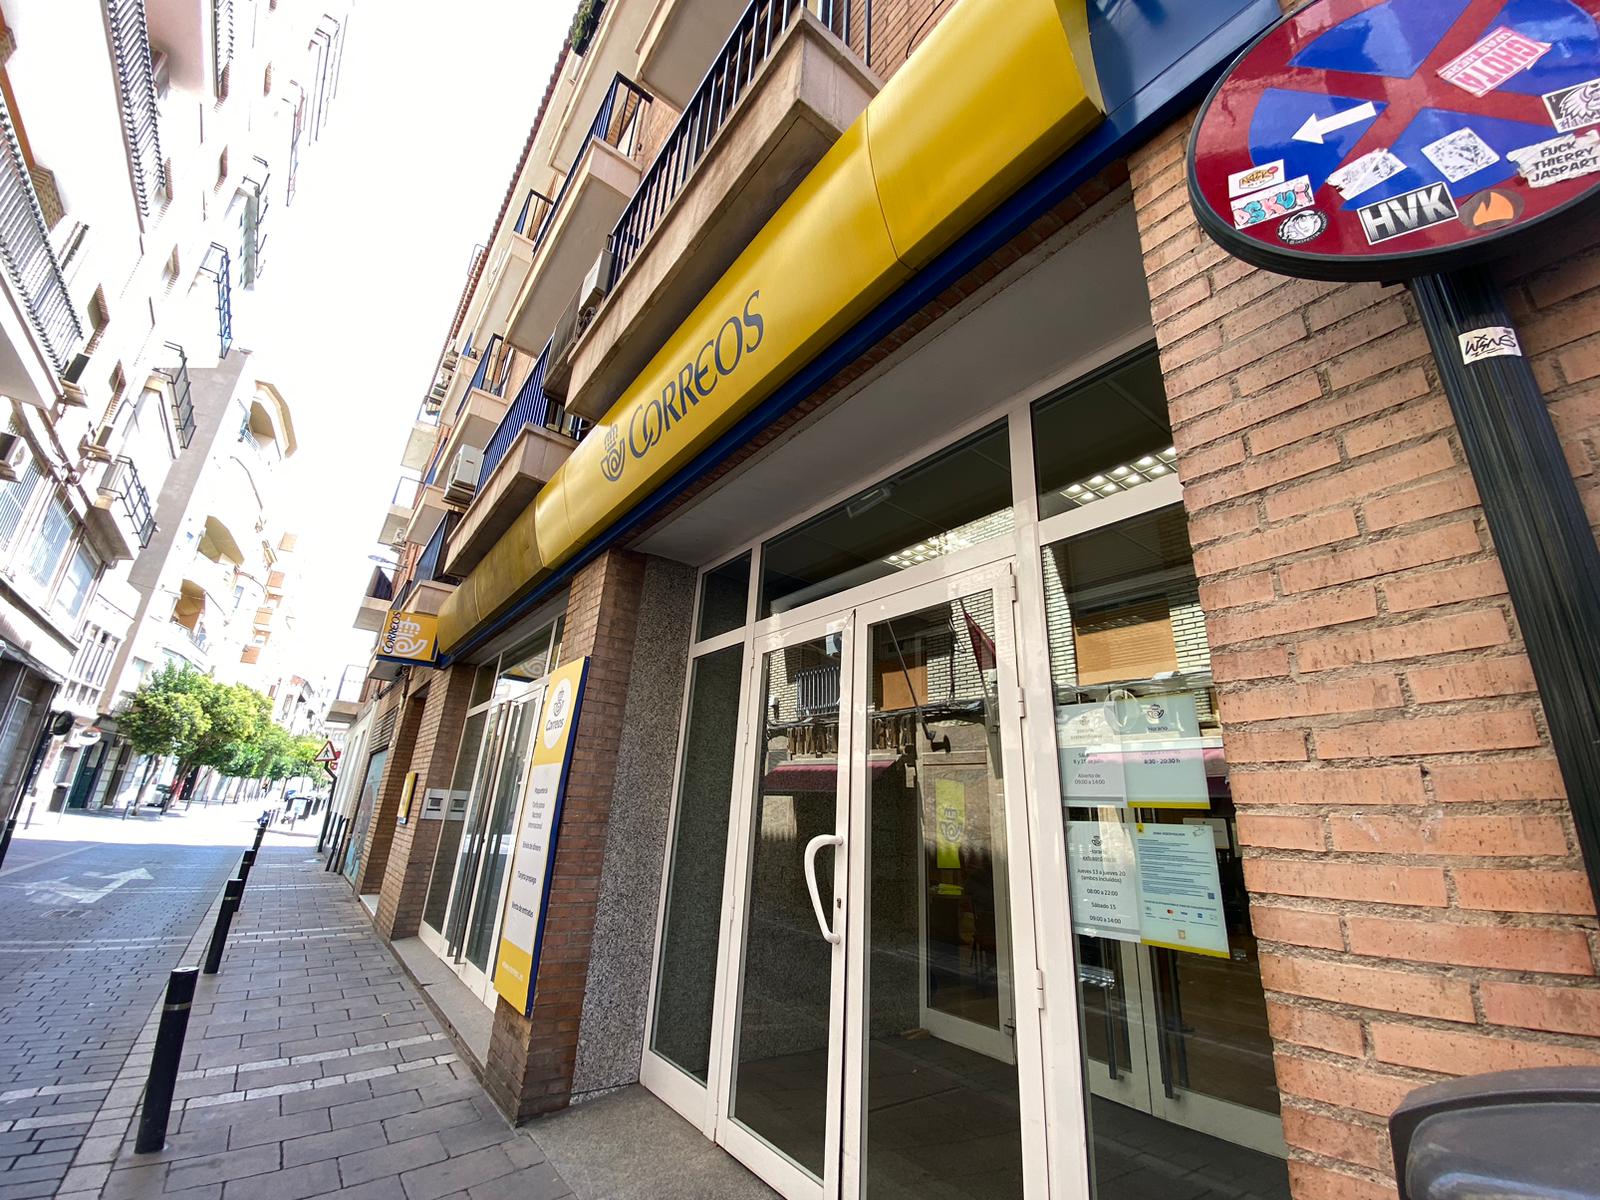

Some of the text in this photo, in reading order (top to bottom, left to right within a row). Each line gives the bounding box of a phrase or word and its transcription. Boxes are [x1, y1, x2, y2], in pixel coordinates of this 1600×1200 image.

[1455, 39, 1539, 90] GHOTA
[1534, 147, 1594, 170] THIERRY
[1540, 141, 1576, 158] FUCK
[1531, 156, 1599, 182] JASPART
[1361, 185, 1455, 241] HVK
[629, 290, 764, 459] CORREOS
[383, 611, 401, 654] CORREOS
[546, 718, 565, 731] Correos
